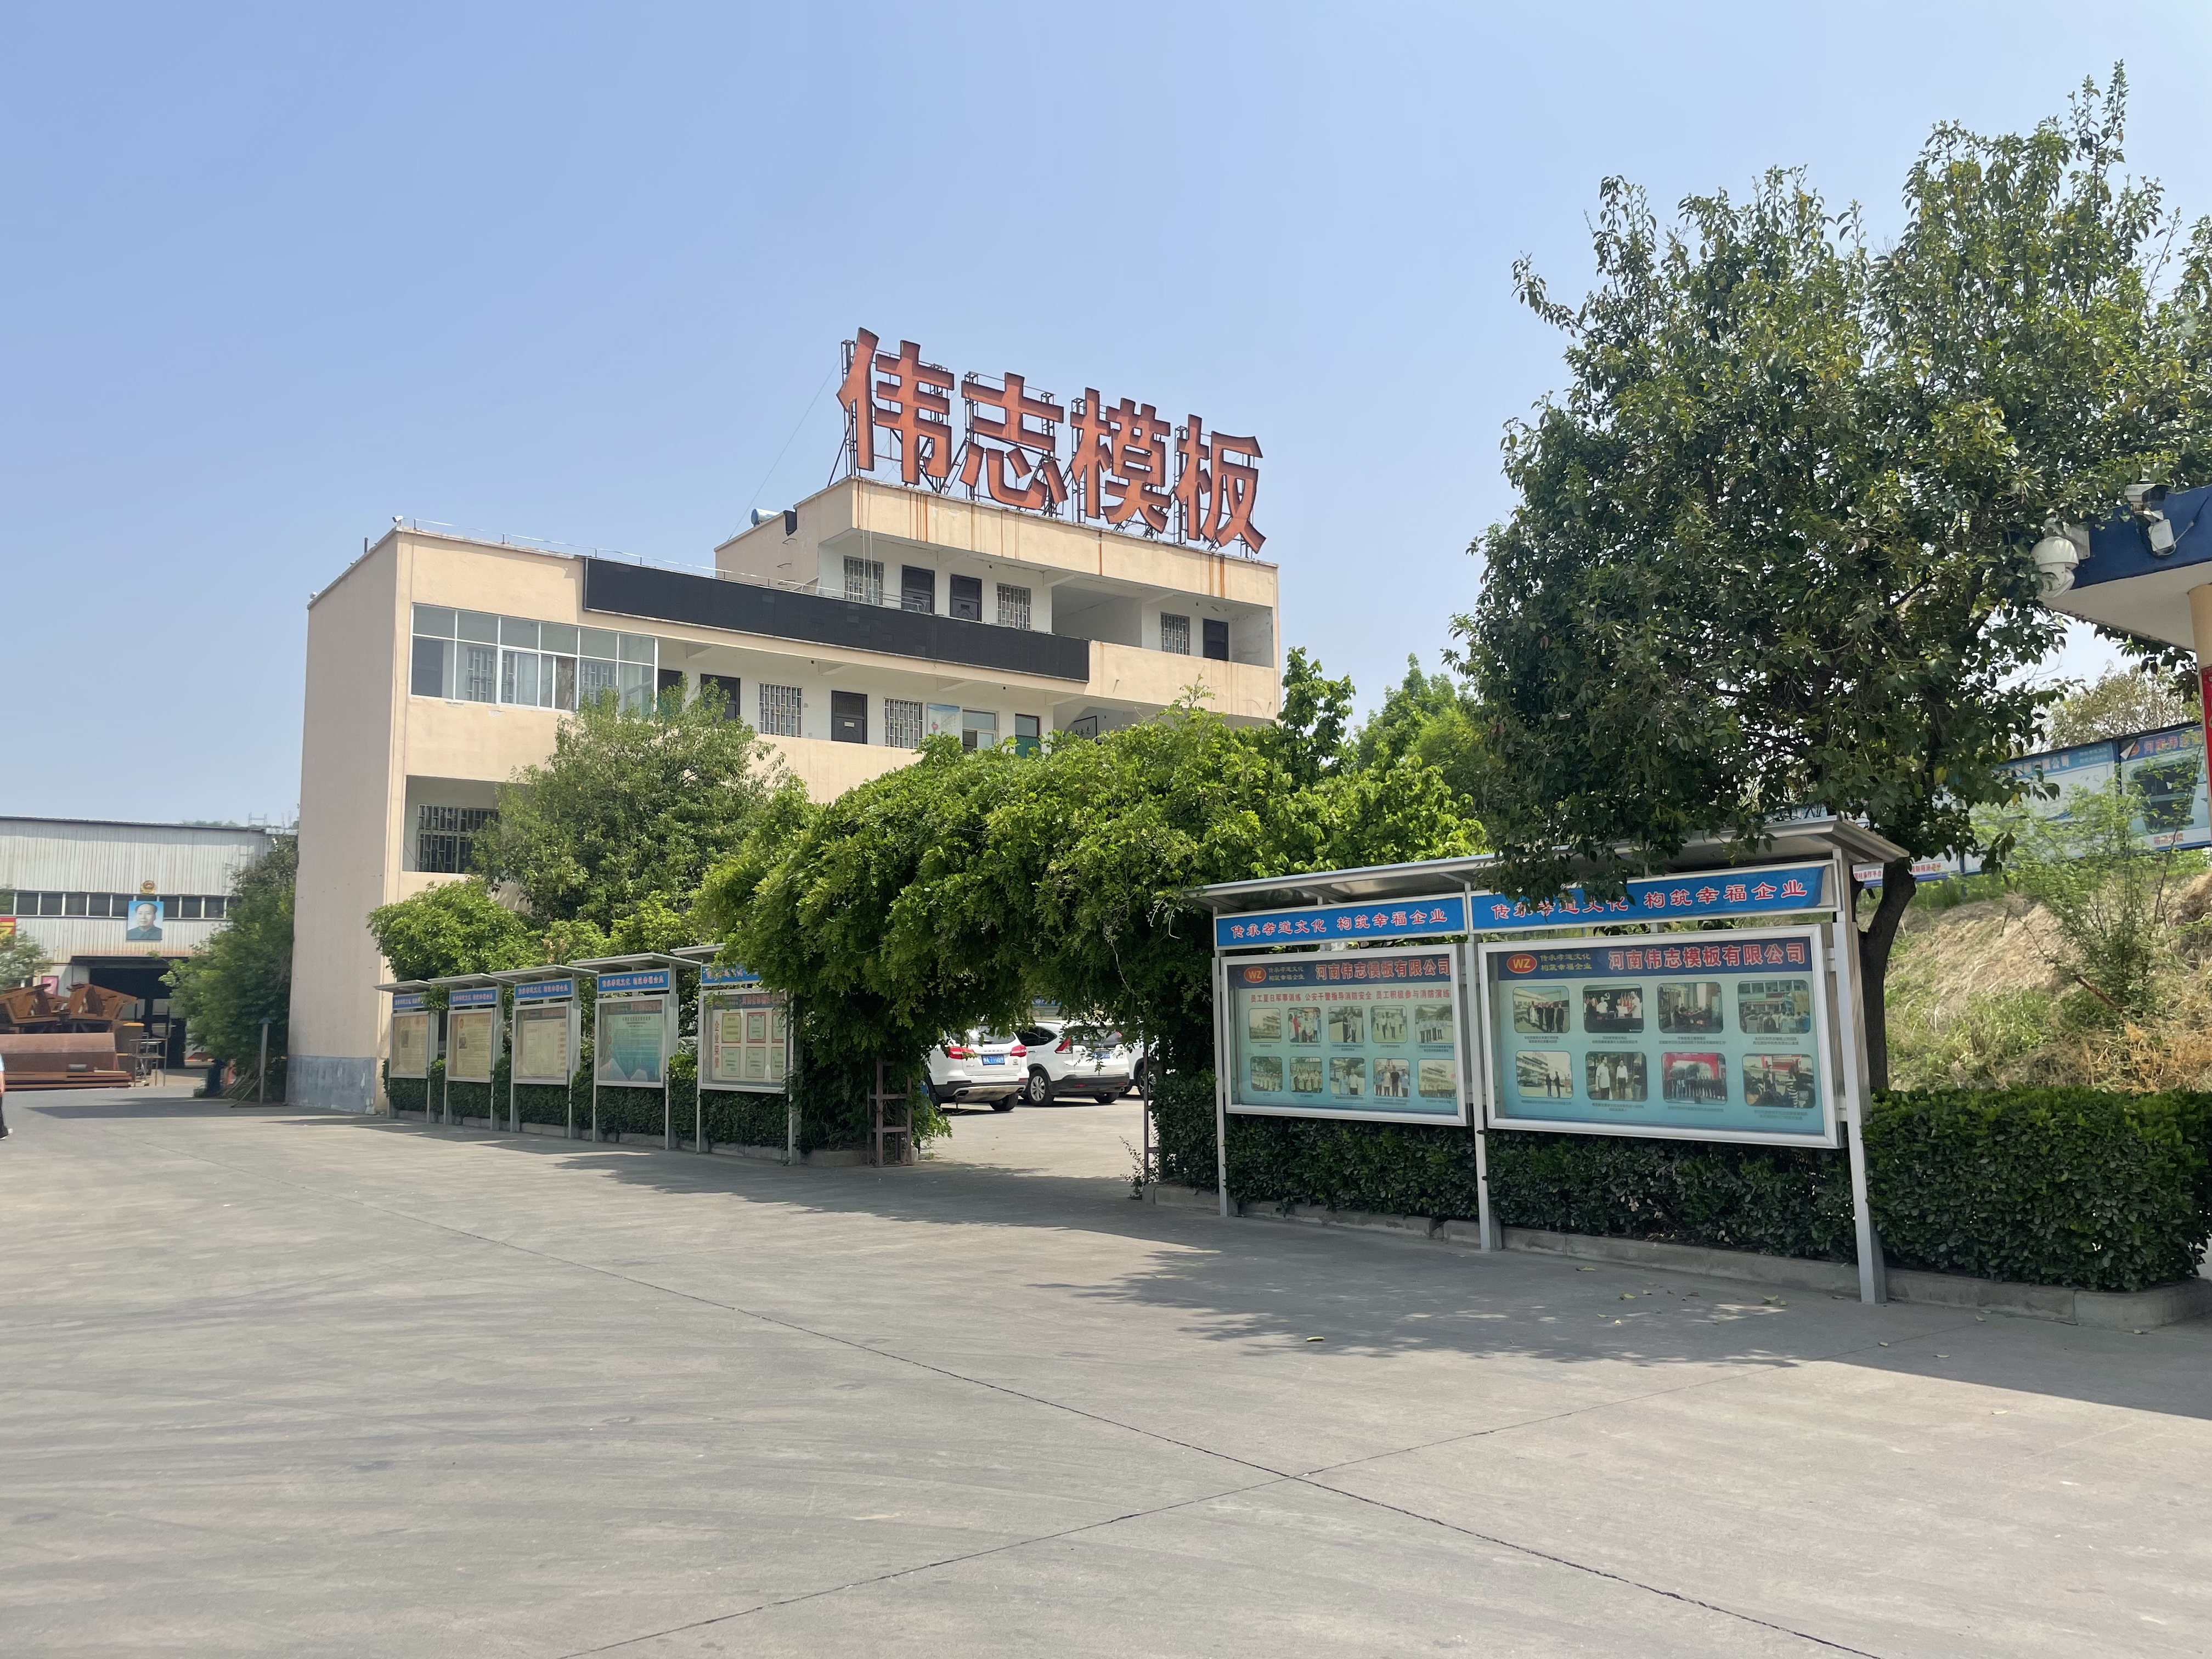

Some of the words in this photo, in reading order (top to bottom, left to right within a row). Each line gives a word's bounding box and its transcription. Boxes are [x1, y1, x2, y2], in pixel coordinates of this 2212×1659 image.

[836, 327, 1267, 554] 伟志模板
[1644, 879, 1807, 909] 构筑幸福企业
[1231, 918, 1327, 939] 传承孝道文化
[1336, 908, 1448, 932] 构筑幸福企业
[1315, 958, 1450, 980] 河南伟志模板有限公司
[1513, 958, 1531, 969] WZ
[1608, 943, 1805, 970] 河南伟志模板有限公司
[1248, 970, 1262, 979] WZ
